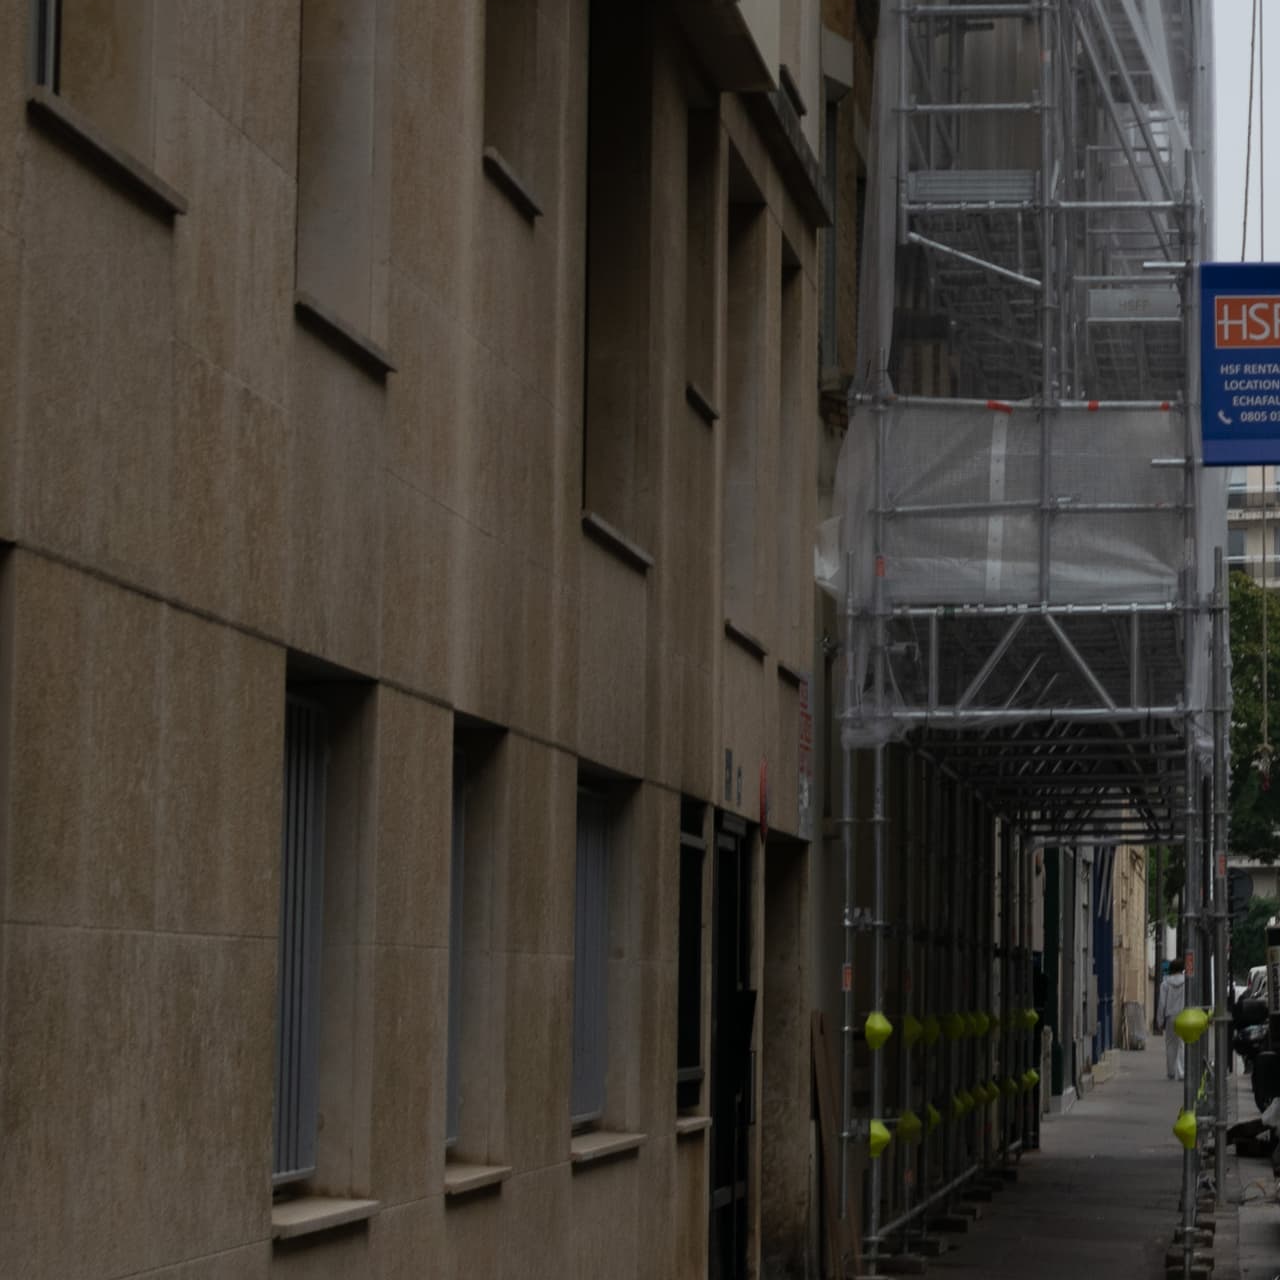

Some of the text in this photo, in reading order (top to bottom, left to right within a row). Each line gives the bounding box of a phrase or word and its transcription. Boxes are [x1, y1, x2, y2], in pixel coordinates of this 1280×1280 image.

[1220, 364, 1242, 374] HSF
[1224, 380, 1280, 391] LOCATION
[1240, 411, 1268, 422] 0805
